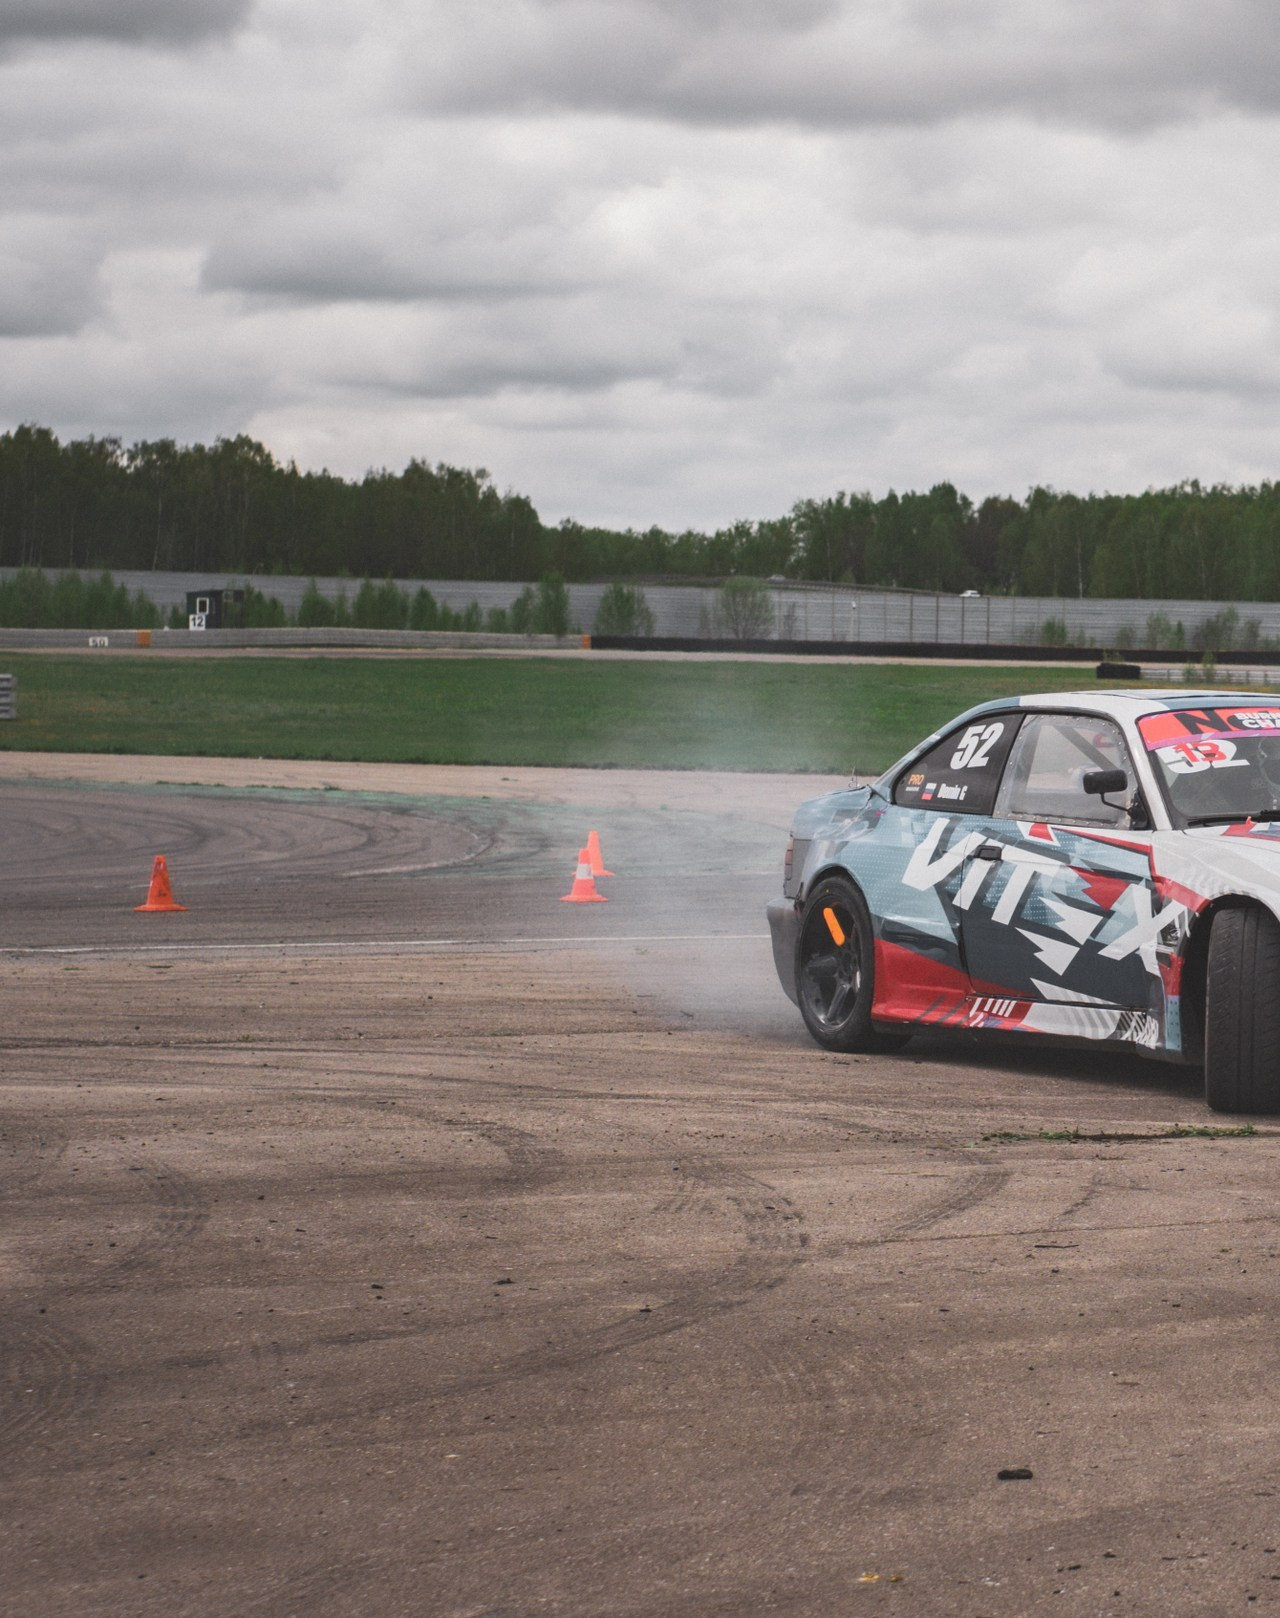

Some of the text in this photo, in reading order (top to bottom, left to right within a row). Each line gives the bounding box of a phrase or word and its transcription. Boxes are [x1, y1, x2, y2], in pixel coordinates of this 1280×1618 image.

[191, 615, 205, 628] 12
[950, 722, 1005, 770] 52
[1173, 741, 1227, 763] 13
[907, 774, 925, 786] PRO
